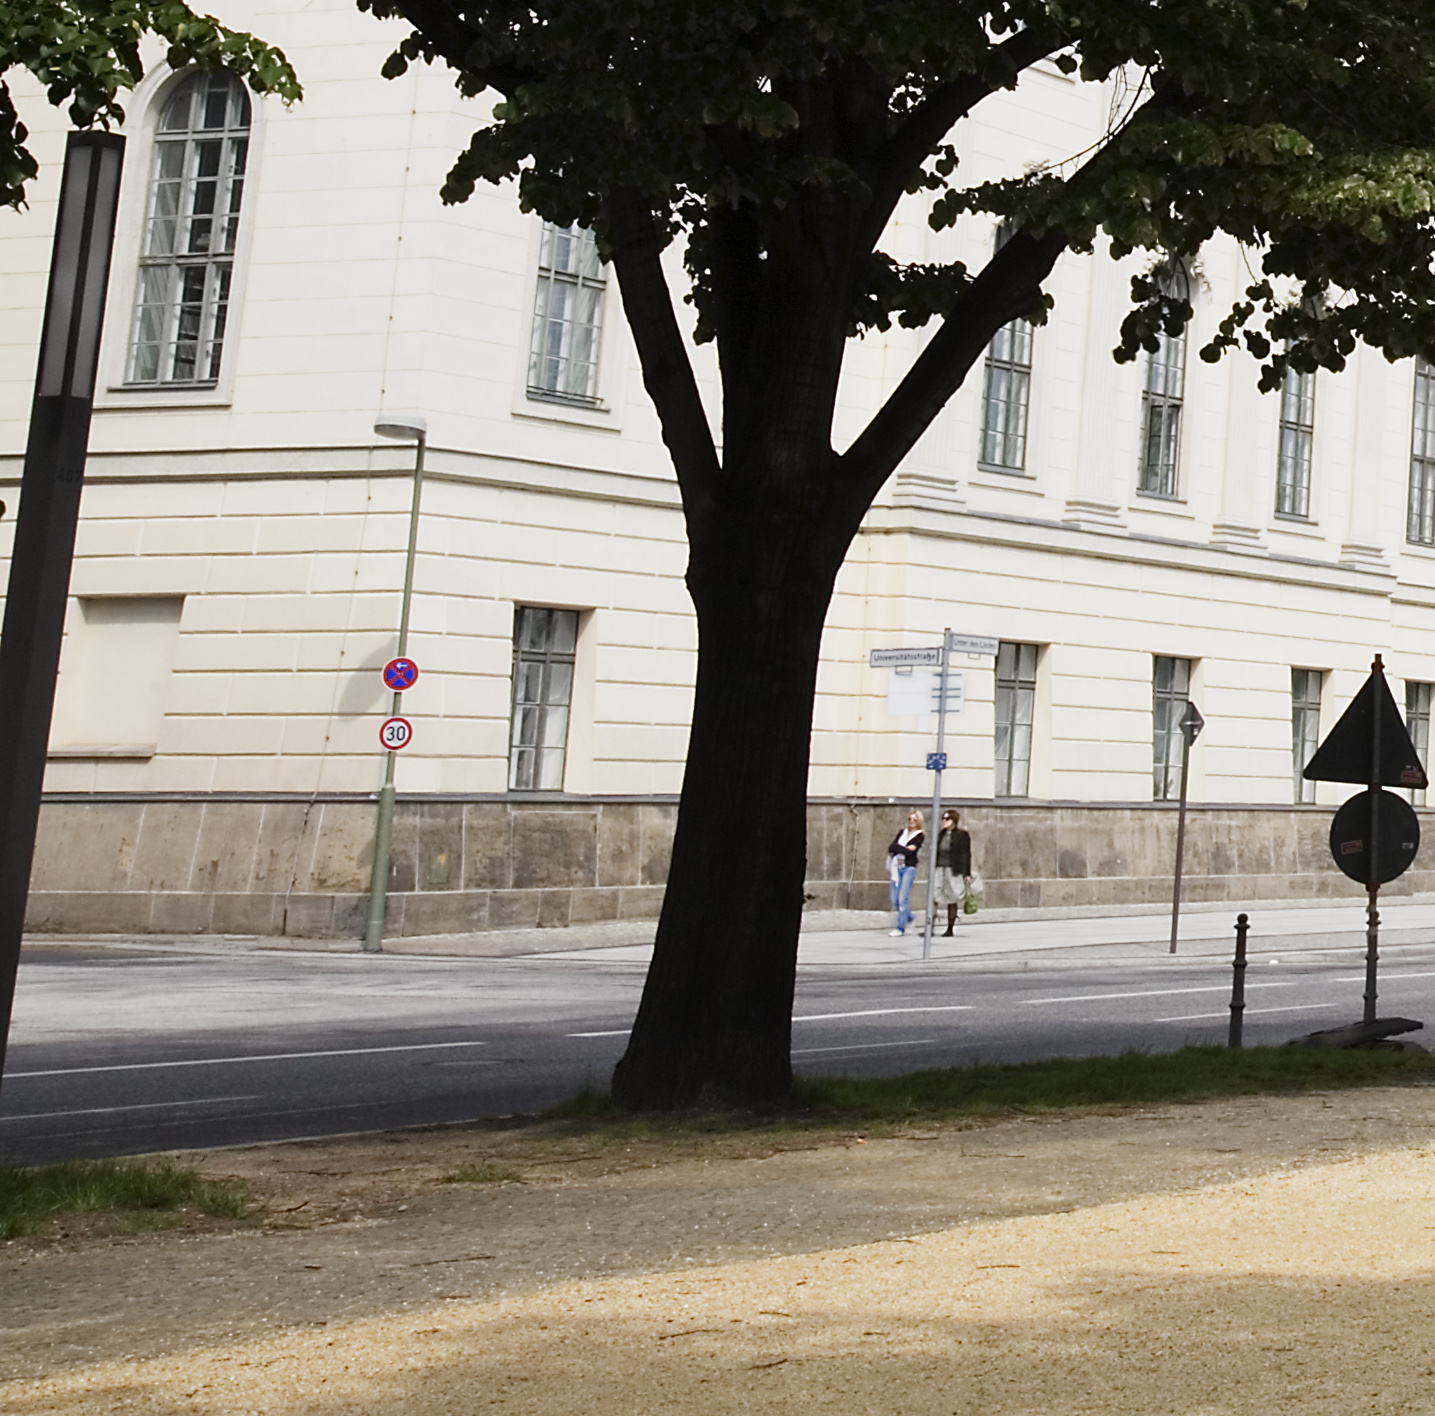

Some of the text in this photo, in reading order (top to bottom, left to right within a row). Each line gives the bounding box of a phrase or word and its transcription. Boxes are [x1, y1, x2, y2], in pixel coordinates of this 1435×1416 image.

[954, 639, 997, 649] Unter den Linden
[873, 652, 936, 662] Universitätsstraße
[386, 725, 405, 741] 30
